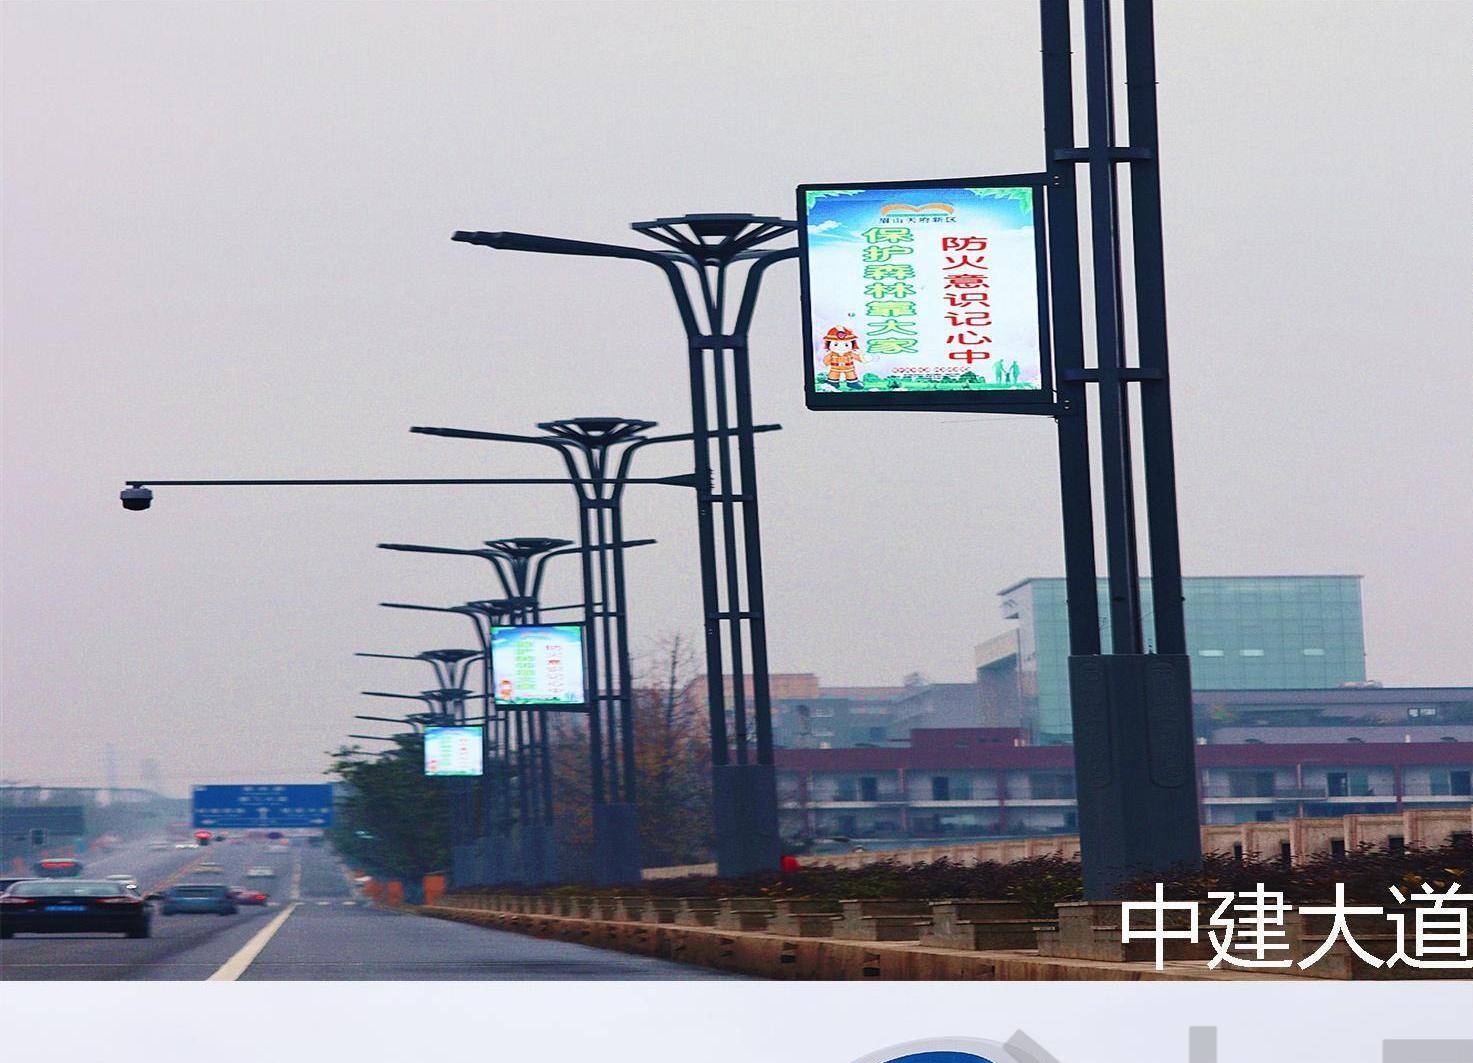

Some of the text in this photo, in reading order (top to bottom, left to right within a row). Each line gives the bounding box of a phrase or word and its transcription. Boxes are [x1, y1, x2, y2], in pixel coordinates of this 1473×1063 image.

[861, 226, 918, 354] 保护森林靠大家
[941, 236, 992, 364] 防火意识记心中
